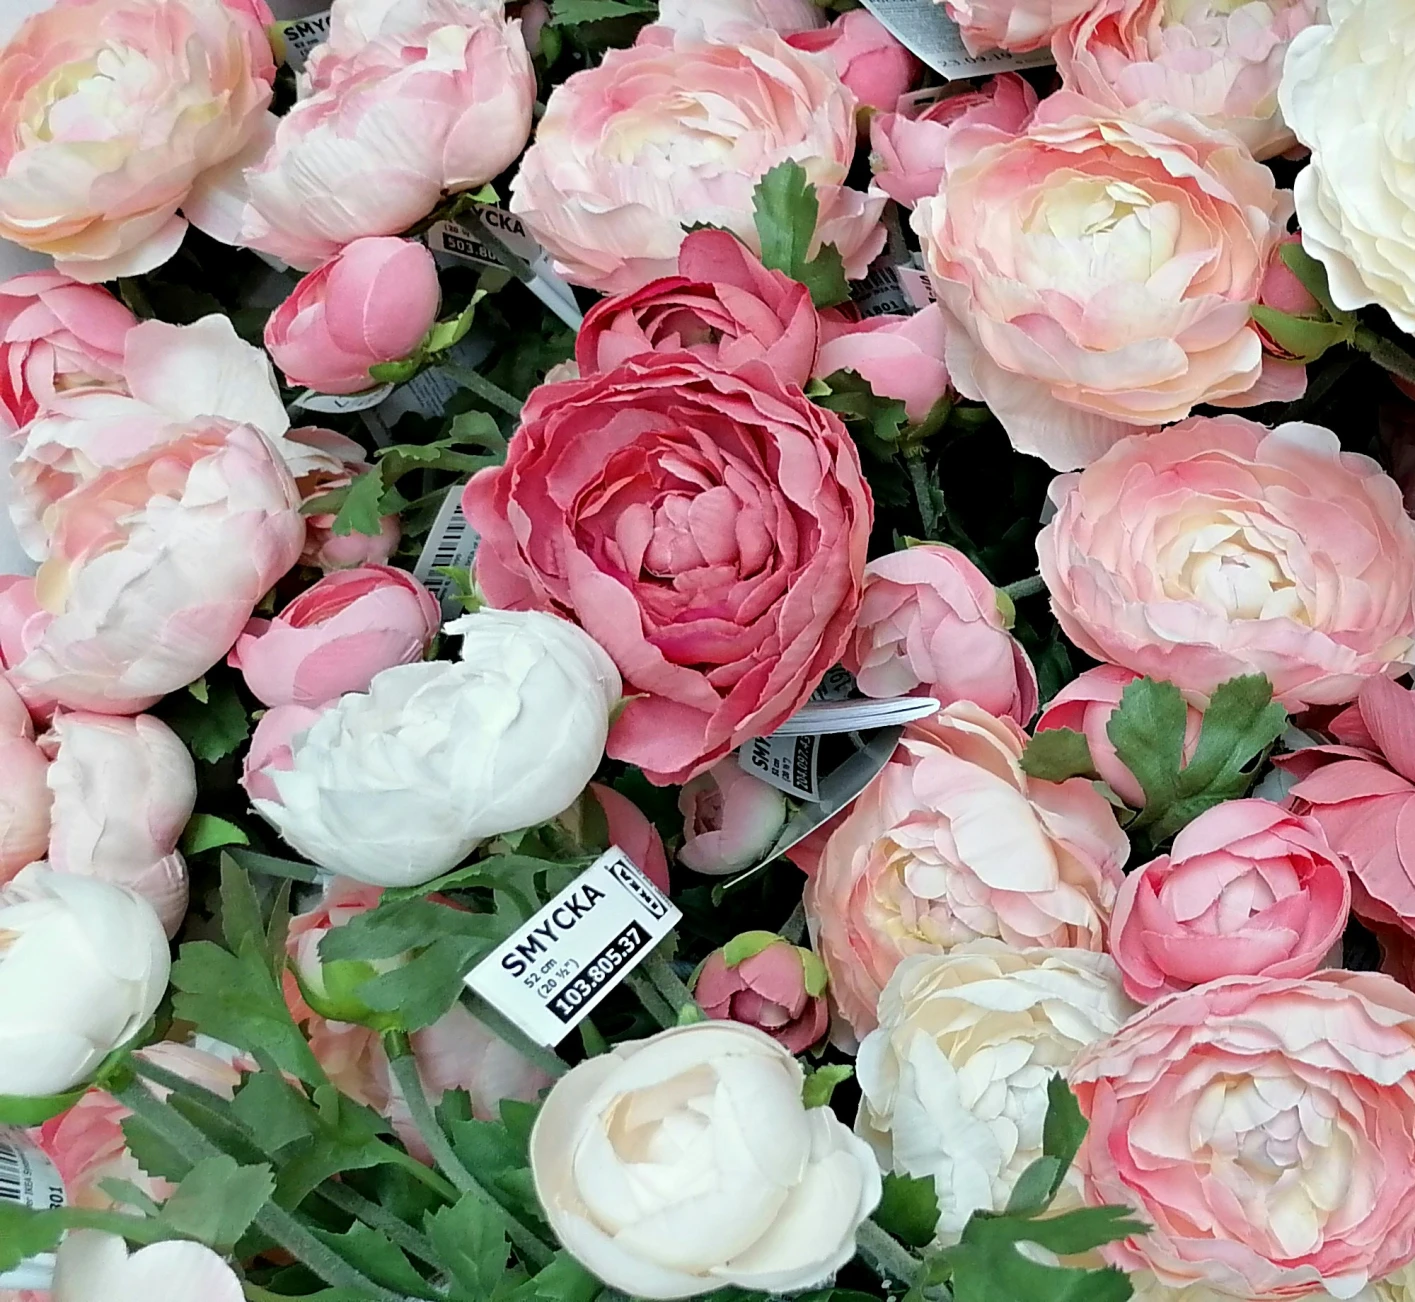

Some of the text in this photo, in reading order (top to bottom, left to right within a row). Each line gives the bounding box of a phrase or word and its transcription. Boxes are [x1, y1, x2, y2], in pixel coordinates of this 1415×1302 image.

[752, 736, 772, 771] SMY
[613, 863, 666, 917] IKEA
[501, 884, 606, 978] SMYCKA
[524, 958, 558, 988] 52 cm
[537, 979, 557, 999] (20
[555, 927, 642, 1016] 103.805.37
